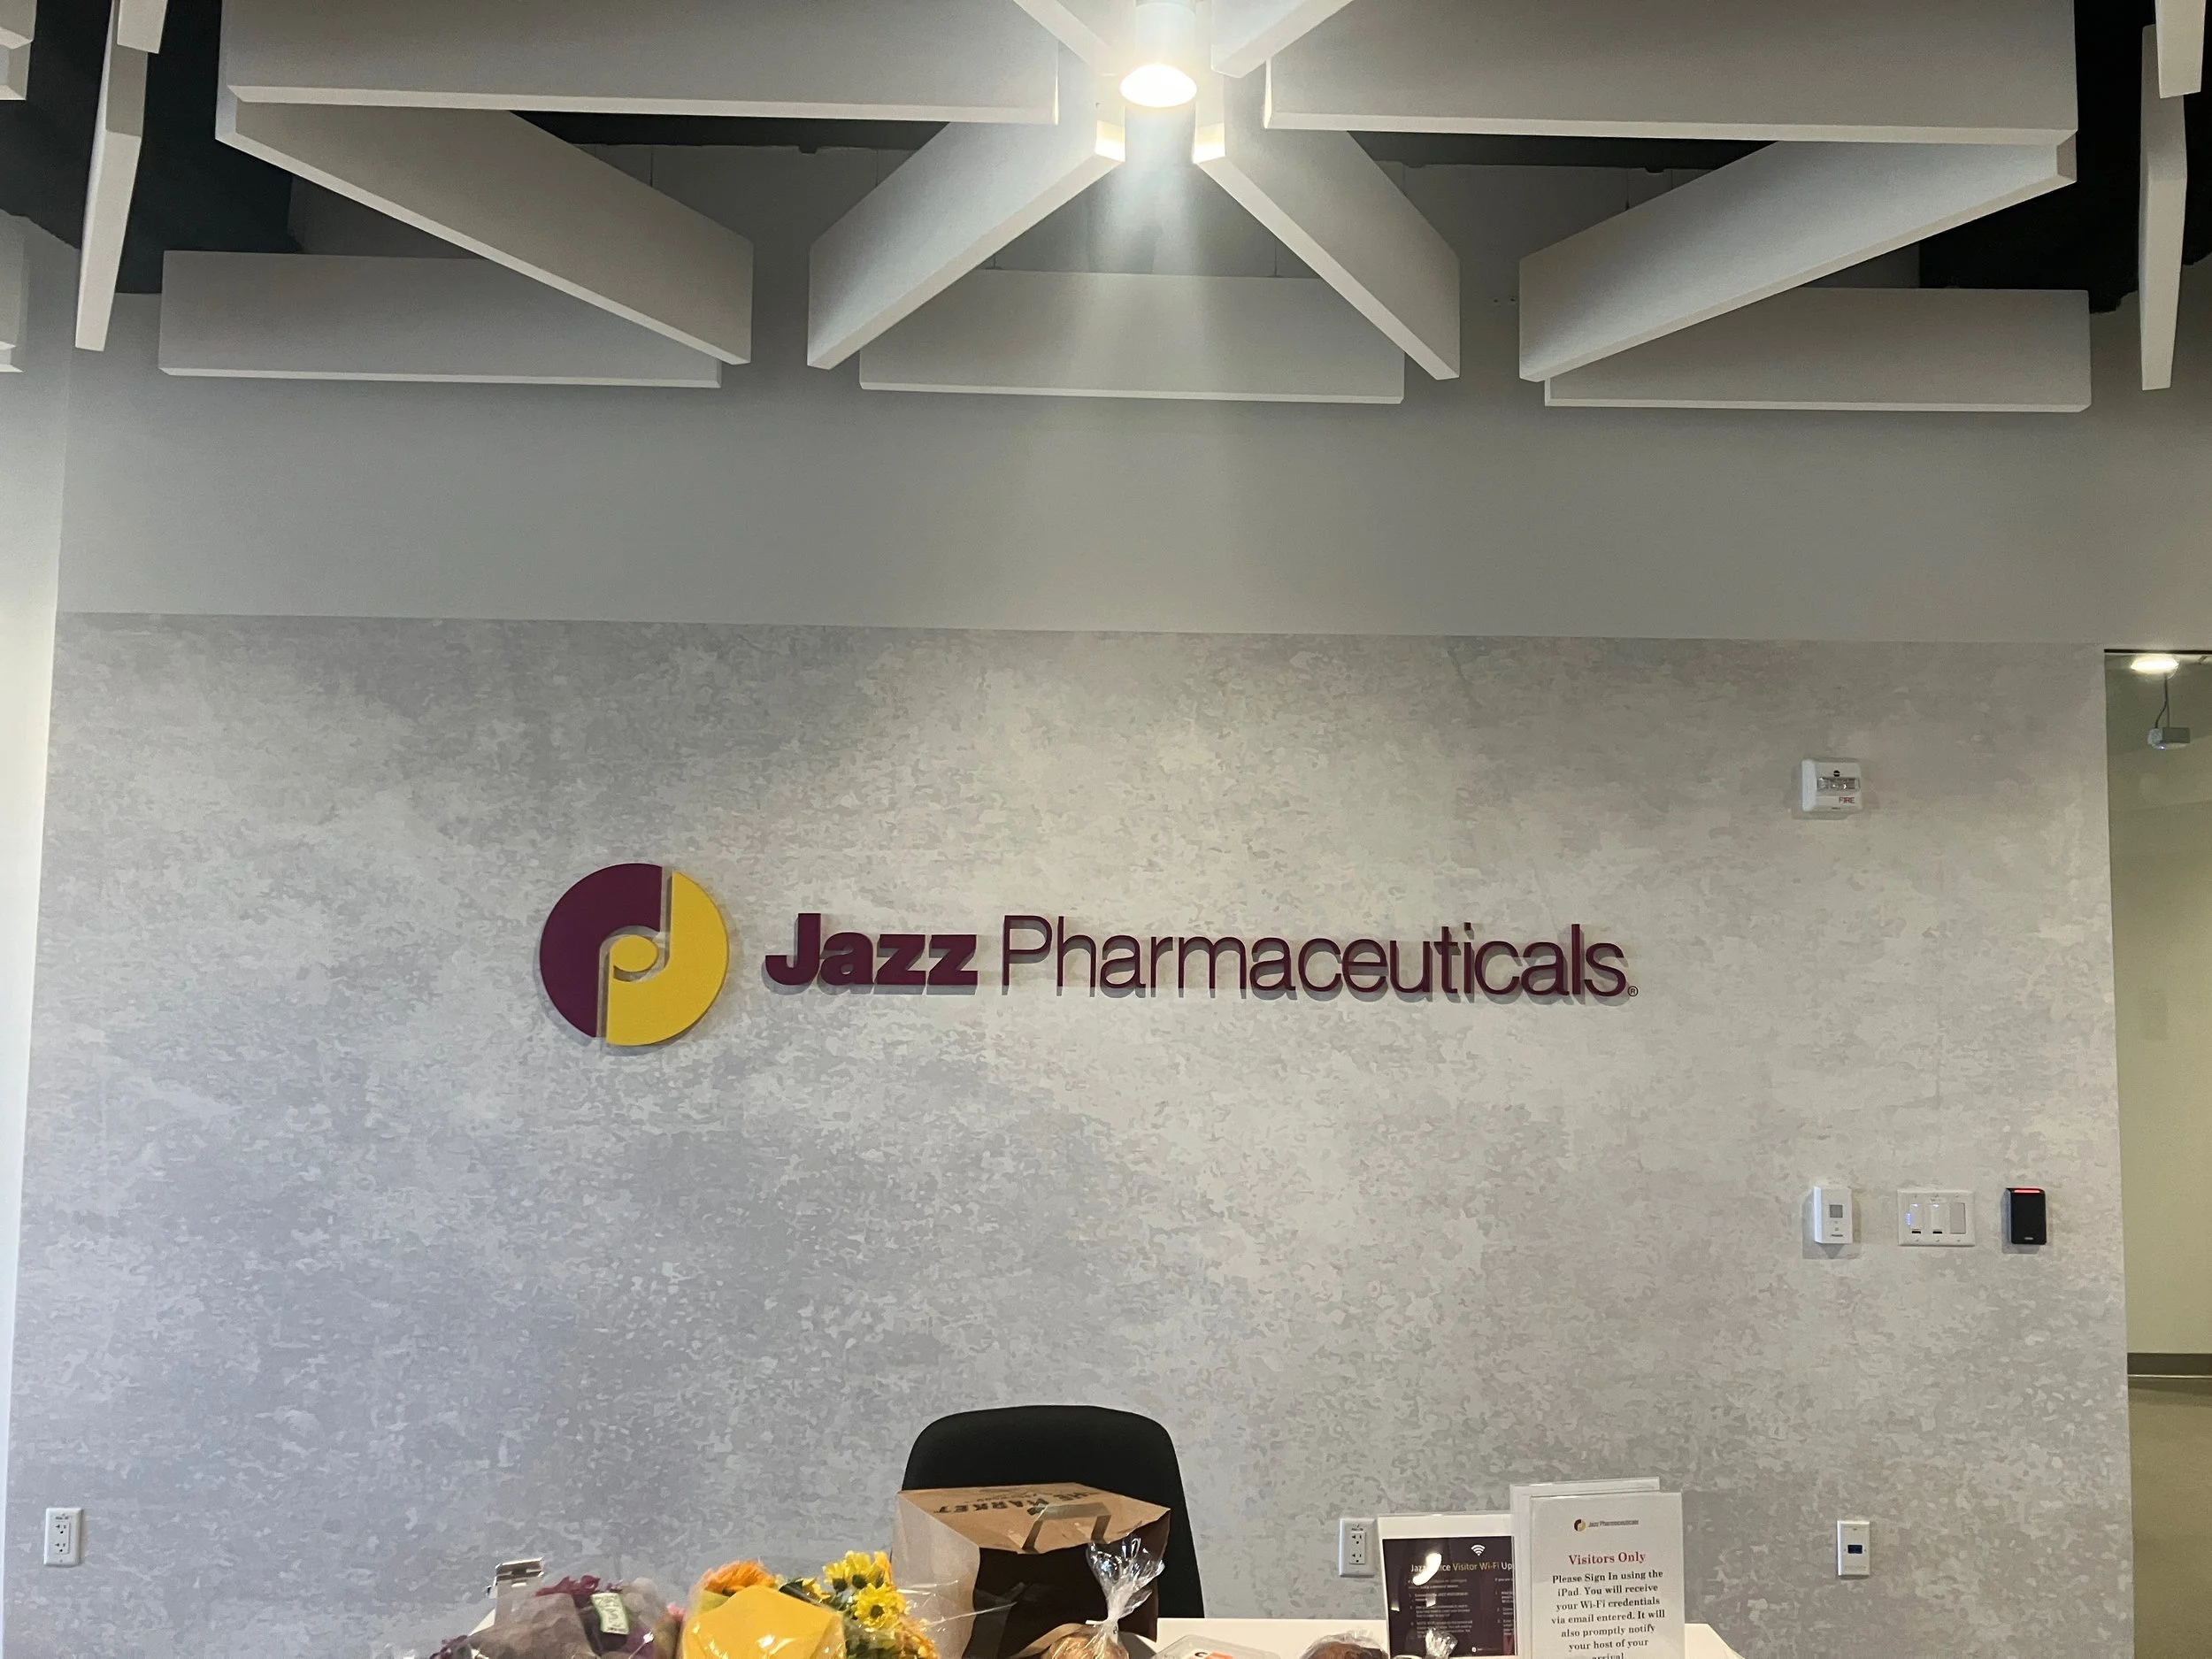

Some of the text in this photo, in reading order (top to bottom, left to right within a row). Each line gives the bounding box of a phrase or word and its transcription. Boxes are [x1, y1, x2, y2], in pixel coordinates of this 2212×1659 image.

[764, 912, 979, 987] Jazz
[1569, 1551, 1646, 1565] Visitors Only
[1451, 1563, 1478, 1571] Visitor
[1479, 1562, 1500, 1571] Wi-Fi
[1552, 1569, 1663, 1585] Please Sign In using the
[1584, 1586, 1602, 1595] You
[1605, 1585, 1623, 1594] will
[1625, 1584, 1659, 1593] receive
[1555, 1596, 1661, 1613] your Wi-Fi credentials
[1551, 1609, 1666, 1625] via email entered. It will
[1561, 1624, 1655, 1638] also promptly notify
[1569, 1639, 1649, 1652] your host of your
